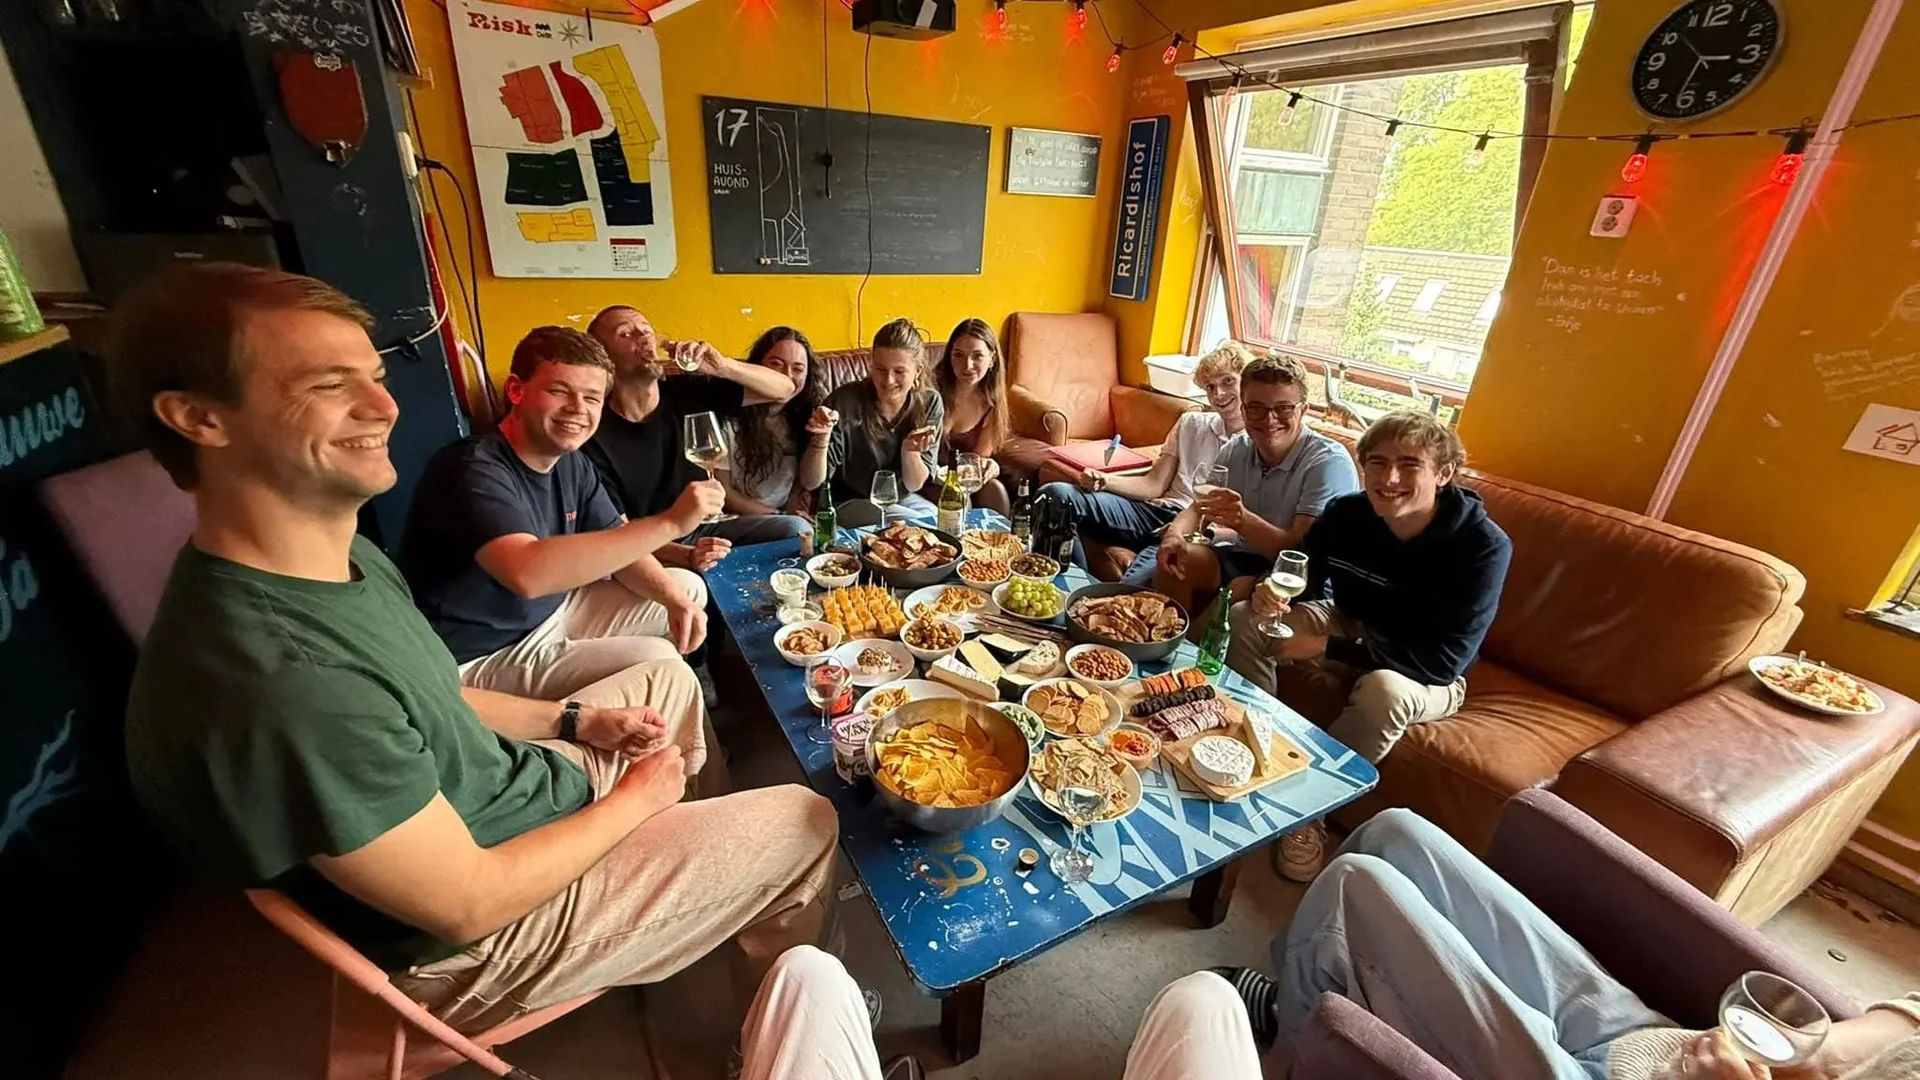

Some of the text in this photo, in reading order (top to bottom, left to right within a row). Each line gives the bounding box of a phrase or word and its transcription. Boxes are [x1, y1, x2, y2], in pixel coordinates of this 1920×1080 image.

[1688, 14, 1698, 28] 11
[1702, 4, 1733, 27] 12
[1739, 9, 1748, 22] 1
[467, 11, 532, 36] Risk
[1747, 24, 1763, 37] 2
[1662, 32, 1678, 45] 10
[1736, 44, 1761, 64] 3
[1647, 52, 1666, 71] 9
[1647, 78, 1660, 90] 8
[1728, 73, 1743, 83] 4
[1655, 94, 1669, 106] 7
[1676, 90, 1696, 109] 6
[1705, 91, 1717, 102] 5
[715, 108, 750, 147] 17
[714, 163, 748, 176] HUIS-
[1117, 141, 1147, 278] Ricardishof
